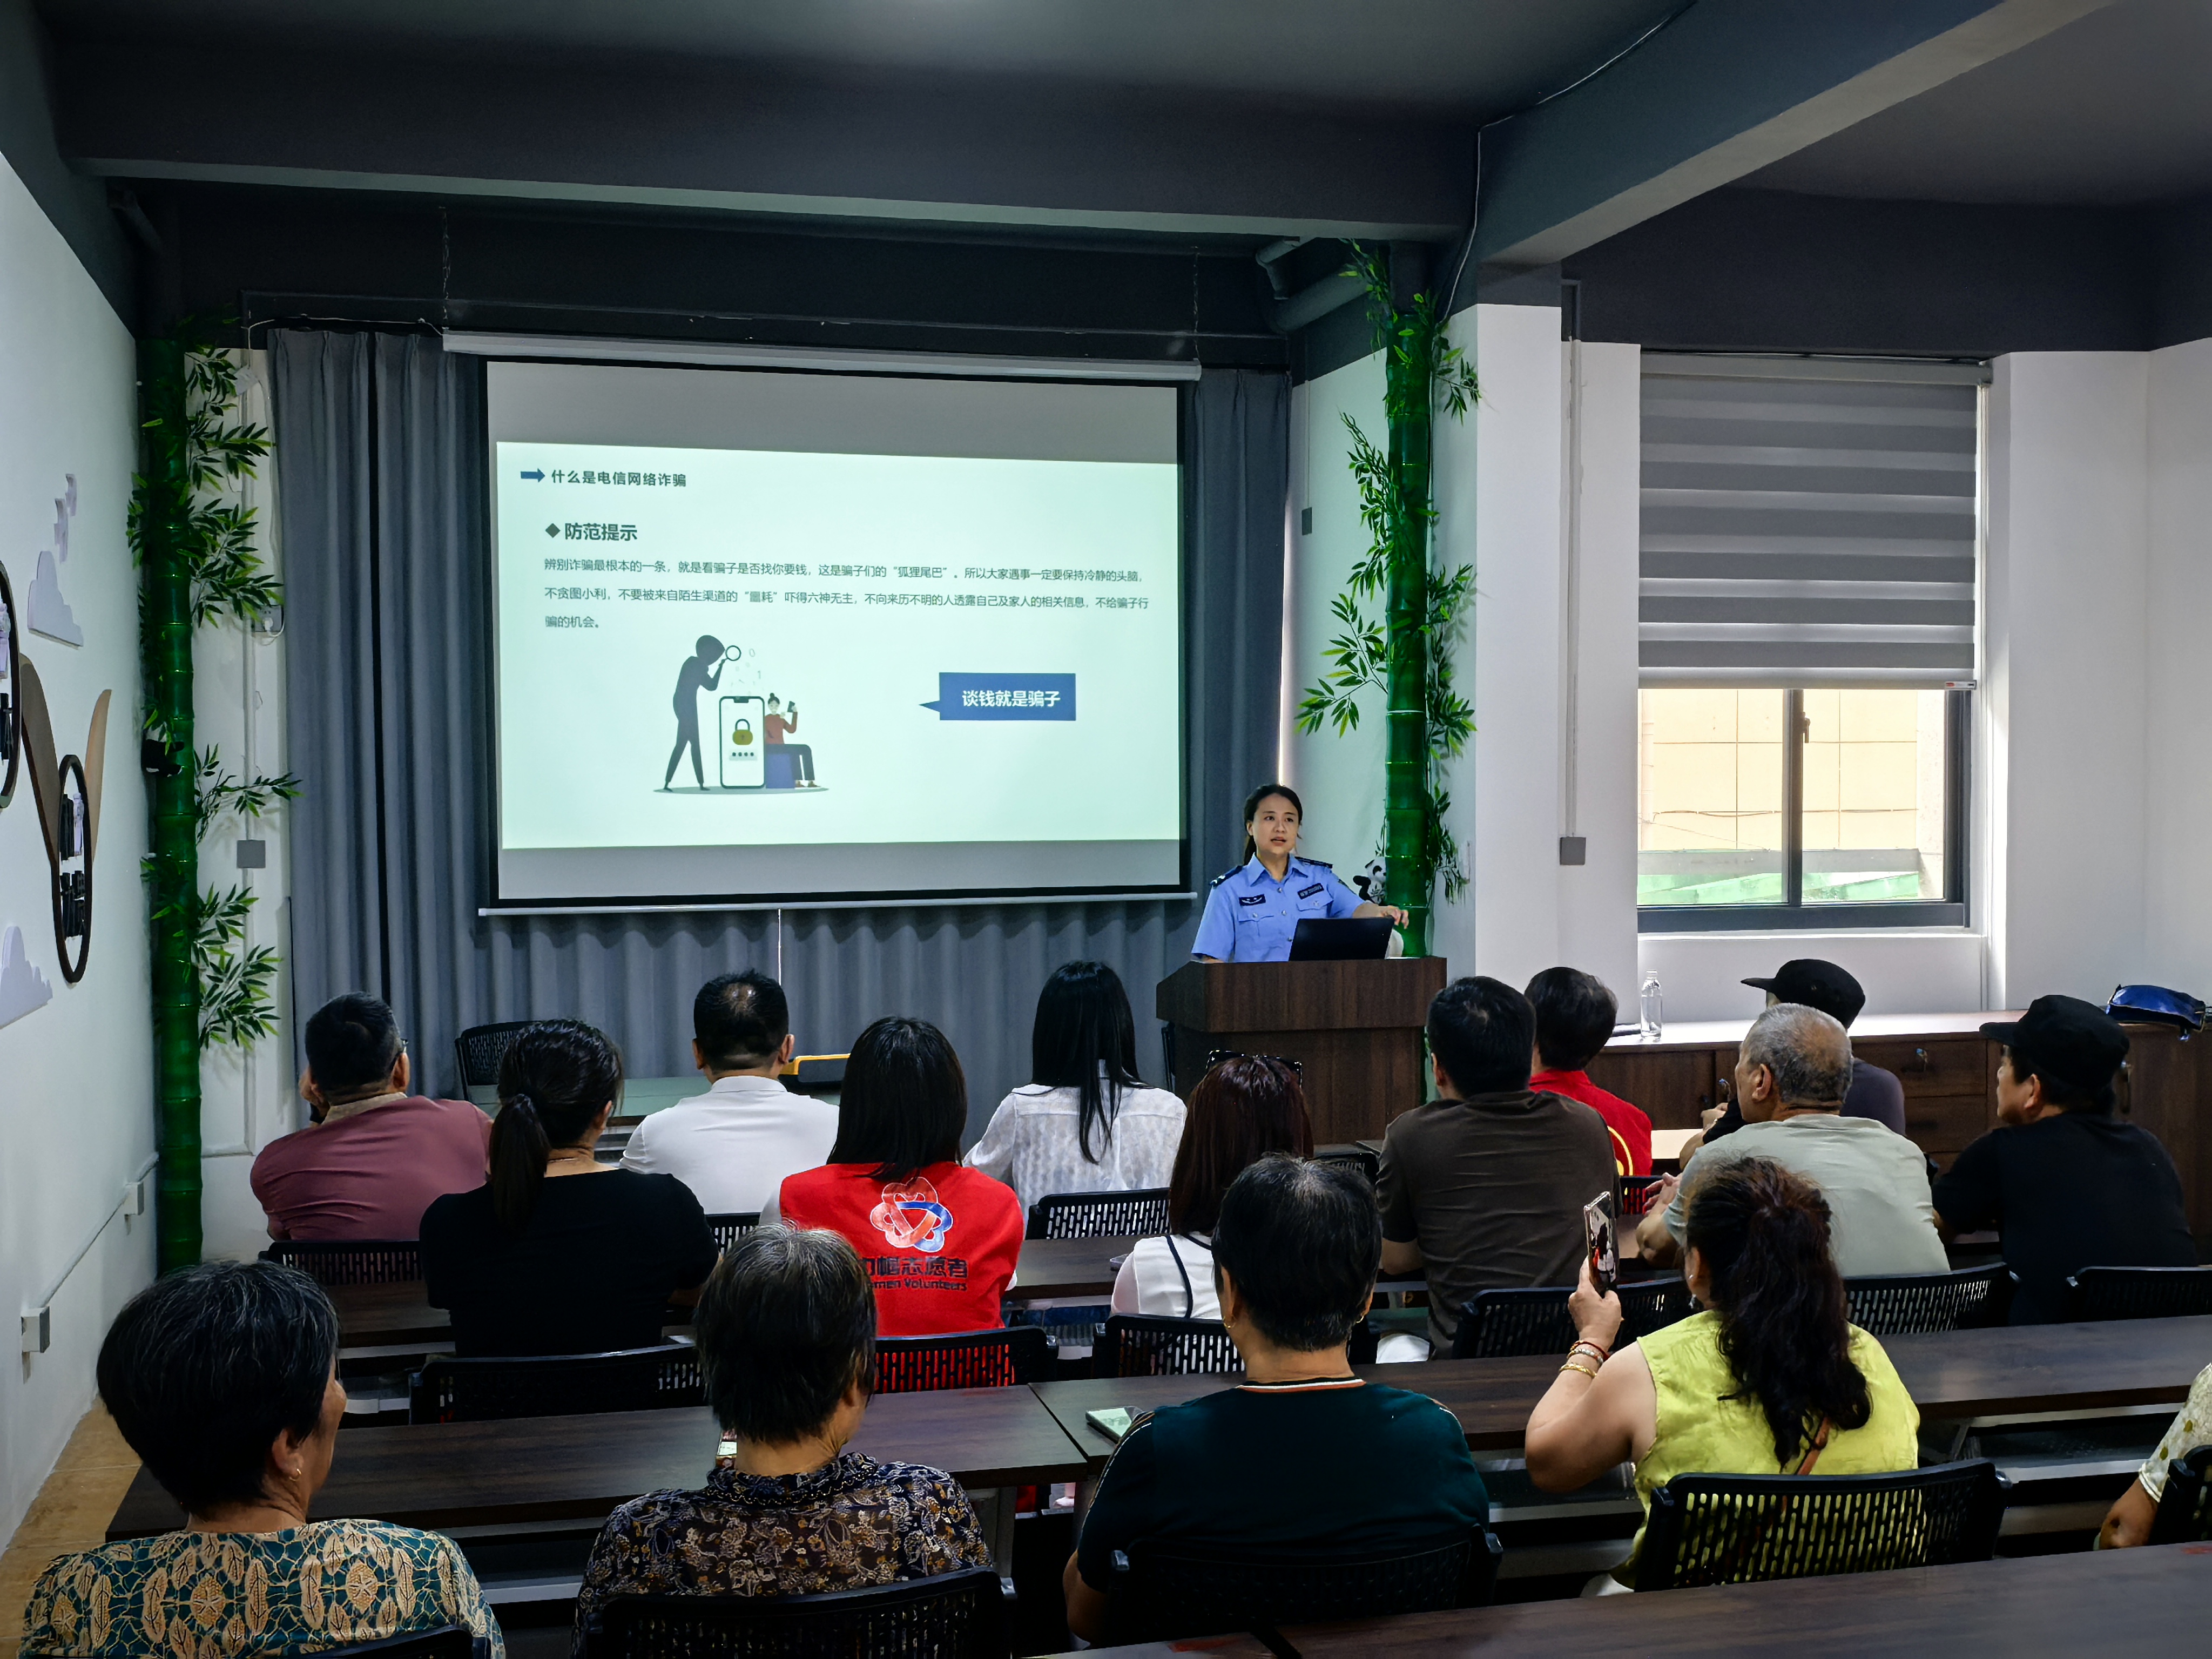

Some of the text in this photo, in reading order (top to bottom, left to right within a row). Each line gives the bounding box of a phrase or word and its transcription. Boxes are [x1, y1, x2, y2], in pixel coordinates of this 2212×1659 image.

[551, 469, 686, 488] 什么是电信网络诈骗
[564, 522, 638, 542] 防范提示
[545, 615, 599, 629] 骗的机会。
[962, 690, 1061, 708] 谈钱就是骗子
[871, 1278, 968, 1291] men Volunteers
